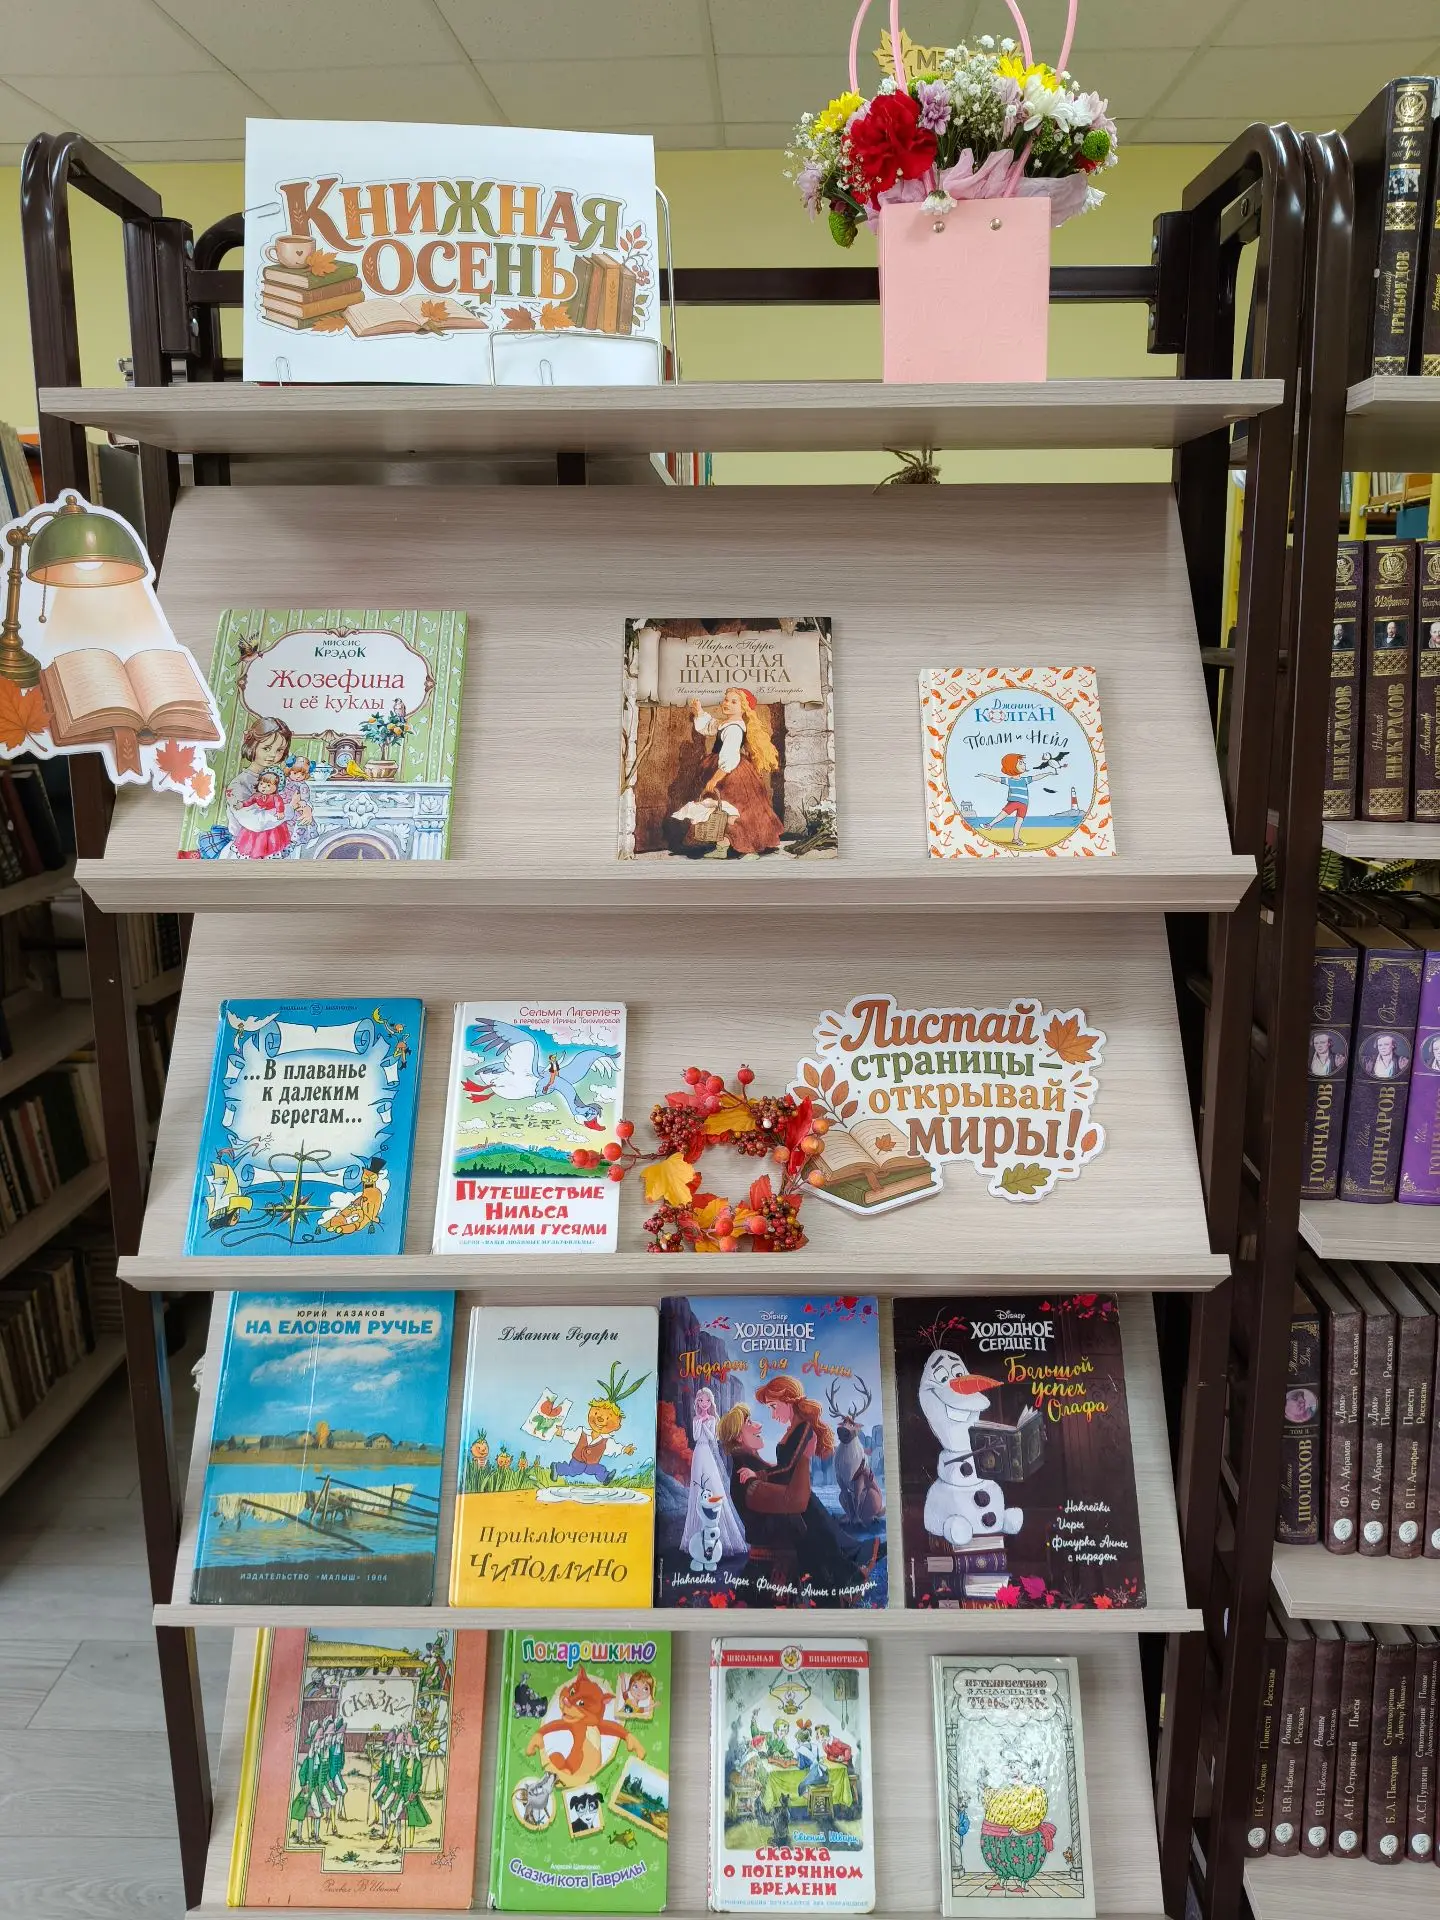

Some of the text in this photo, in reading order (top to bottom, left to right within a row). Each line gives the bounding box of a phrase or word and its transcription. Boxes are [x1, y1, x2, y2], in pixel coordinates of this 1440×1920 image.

[280, 177, 623, 253] КНИЖНАЯ
[361, 238, 578, 300] ОСЕНЬ
[685, 653, 785, 668] КРАСНАЯ
[692, 639, 733, 654] Шарль
[267, 668, 406, 693] Жозефина
[679, 668, 791, 684] ШАПОЧКА
[283, 694, 385, 713] и её куклы
[1333, 685, 1352, 781] НЕКРАСОВ
[1385, 683, 1405, 779] НЕКРАСОВ
[840, 999, 1040, 1051] Листай
[283, 1063, 367, 1081] плаванье
[262, 1085, 360, 1105] к далеким
[868, 1078, 1067, 1115] открывай
[270, 1108, 362, 1129] берегам...
[1310, 1083, 1333, 1182] ГОНЧАРОВ
[906, 1108, 1083, 1168] миры!
[1370, 1086, 1396, 1185] ГОНЧАРОВ
[245, 1320, 434, 1335] НА ЕЛОВОМ РУЧЬЕ
[498, 1326, 620, 1347] Джанни Родари
[732, 1322, 816, 1341] ХОЛОДНОЕ
[970, 1321, 1055, 1340] ХОЛОДНОЕ
[741, 1337, 793, 1353] СЕРДЦЕ
[978, 1337, 1031, 1353] СЕРДЦЕ
[1004, 1354, 1094, 1384] Большой
[1348, 1333, 1360, 1424] Повести Рассказы
[1380, 1335, 1394, 1426] Повести Рассказы
[1047, 1399, 1109, 1423] Олафа
[1402, 1388, 1415, 1425] Повести
[1416, 1382, 1428, 1424] Рассказы
[1340, 1440, 1353, 1479] Абрамов
[1371, 1442, 1384, 1481] Абрамов
[1407, 1441, 1420, 1483] Астафьев
[1298, 1439, 1312, 1522] ШОЛОХОВ
[1064, 1500, 1110, 1514] Наклейки
[479, 1526, 628, 1547] Приключения
[1056, 1517, 1085, 1533] Игры
[1051, 1535, 1128, 1551] Фигурка Анны
[1076, 1552, 1118, 1566] нарядом
[240, 1573, 309, 1581] ИЗДАТЕЛЬСТВО
[671, 1571, 717, 1587] Наклейки
[724, 1572, 750, 1588] Игры
[756, 1576, 798, 1596] Фигурка
[801, 1584, 829, 1597] Анны
[726, 1655, 864, 1664] ШКОЛЬНАЯ БИБЛИОТЕКА
[1263, 1669, 1276, 1707] Рассказы
[341, 1689, 412, 1718] СКАЗКИ
[1349, 1699, 1360, 1728] Пьесы
[1281, 1713, 1293, 1745] Романы
[1293, 1707, 1305, 1744] Рассказы
[1313, 1715, 1325, 1747] Романы
[1256, 1764, 1267, 1793] Лесков
[1283, 1760, 1295, 1793] Набоков
[1316, 1761, 1328, 1796] Набоков
[1344, 1741, 1358, 1794] Островский
[1386, 1755, 1399, 1799] Пастернак
[509, 1858, 647, 1888] Сказки кота Гаврилы
[742, 1864, 864, 1879] ПОТЕРЯННОМ
[750, 1881, 837, 1896] ВРЕМЕНИ
